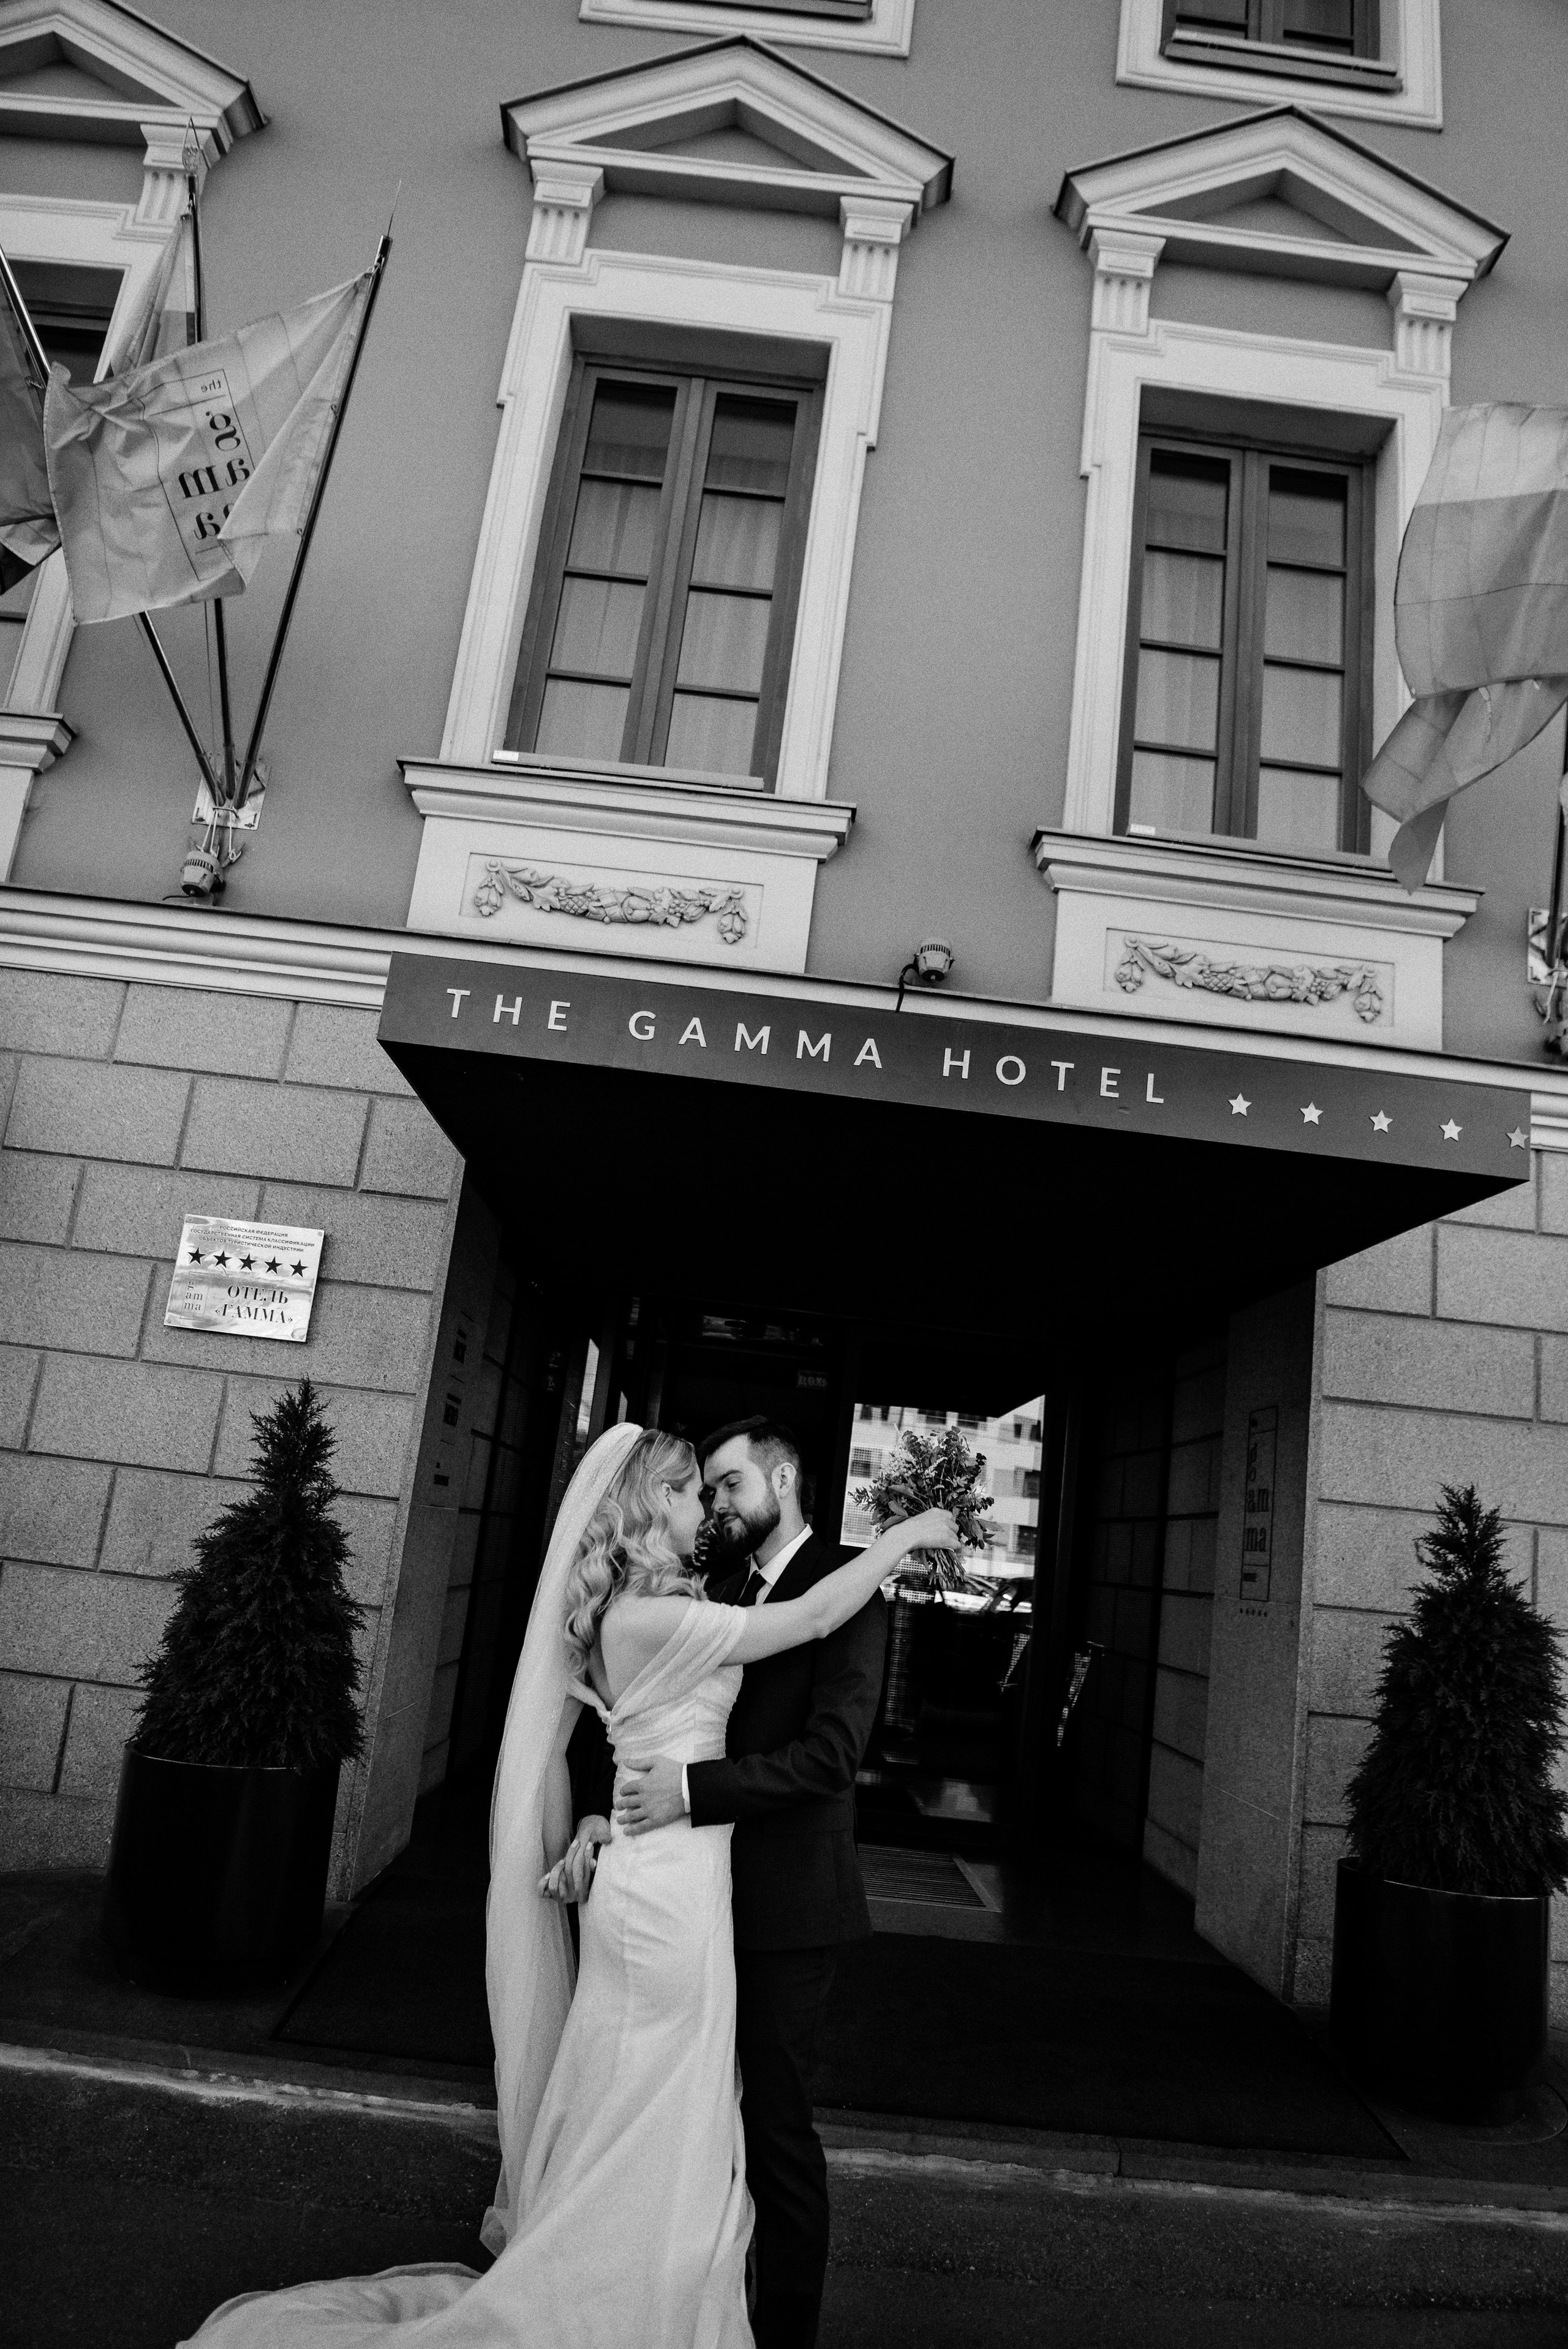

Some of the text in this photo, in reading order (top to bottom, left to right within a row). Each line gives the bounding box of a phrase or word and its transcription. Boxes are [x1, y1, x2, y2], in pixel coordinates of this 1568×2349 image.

[446, 987, 1165, 1105] THE GAMMA HOTEL
[190, 1228, 241, 1239] ГОСУДАРСТВЕННАЯ
[267, 1237, 315, 1247] КЛАССИФИКАЦИИ
[219, 1225, 288, 1238] РОССИЙСКАЯ ФЕДЕРАЦИЯ
[227, 1239, 272, 1249] ТУРИСТИЧЕСКОЙ
[186, 1292, 203, 1300] am
[227, 1284, 288, 1305] ОТЕЛЬ
[184, 1302, 202, 1311] ma
[215, 1304, 293, 1323] «ГАММА»
[1247, 1488, 1269, 1512] am
[1245, 1527, 1267, 1552] ma
